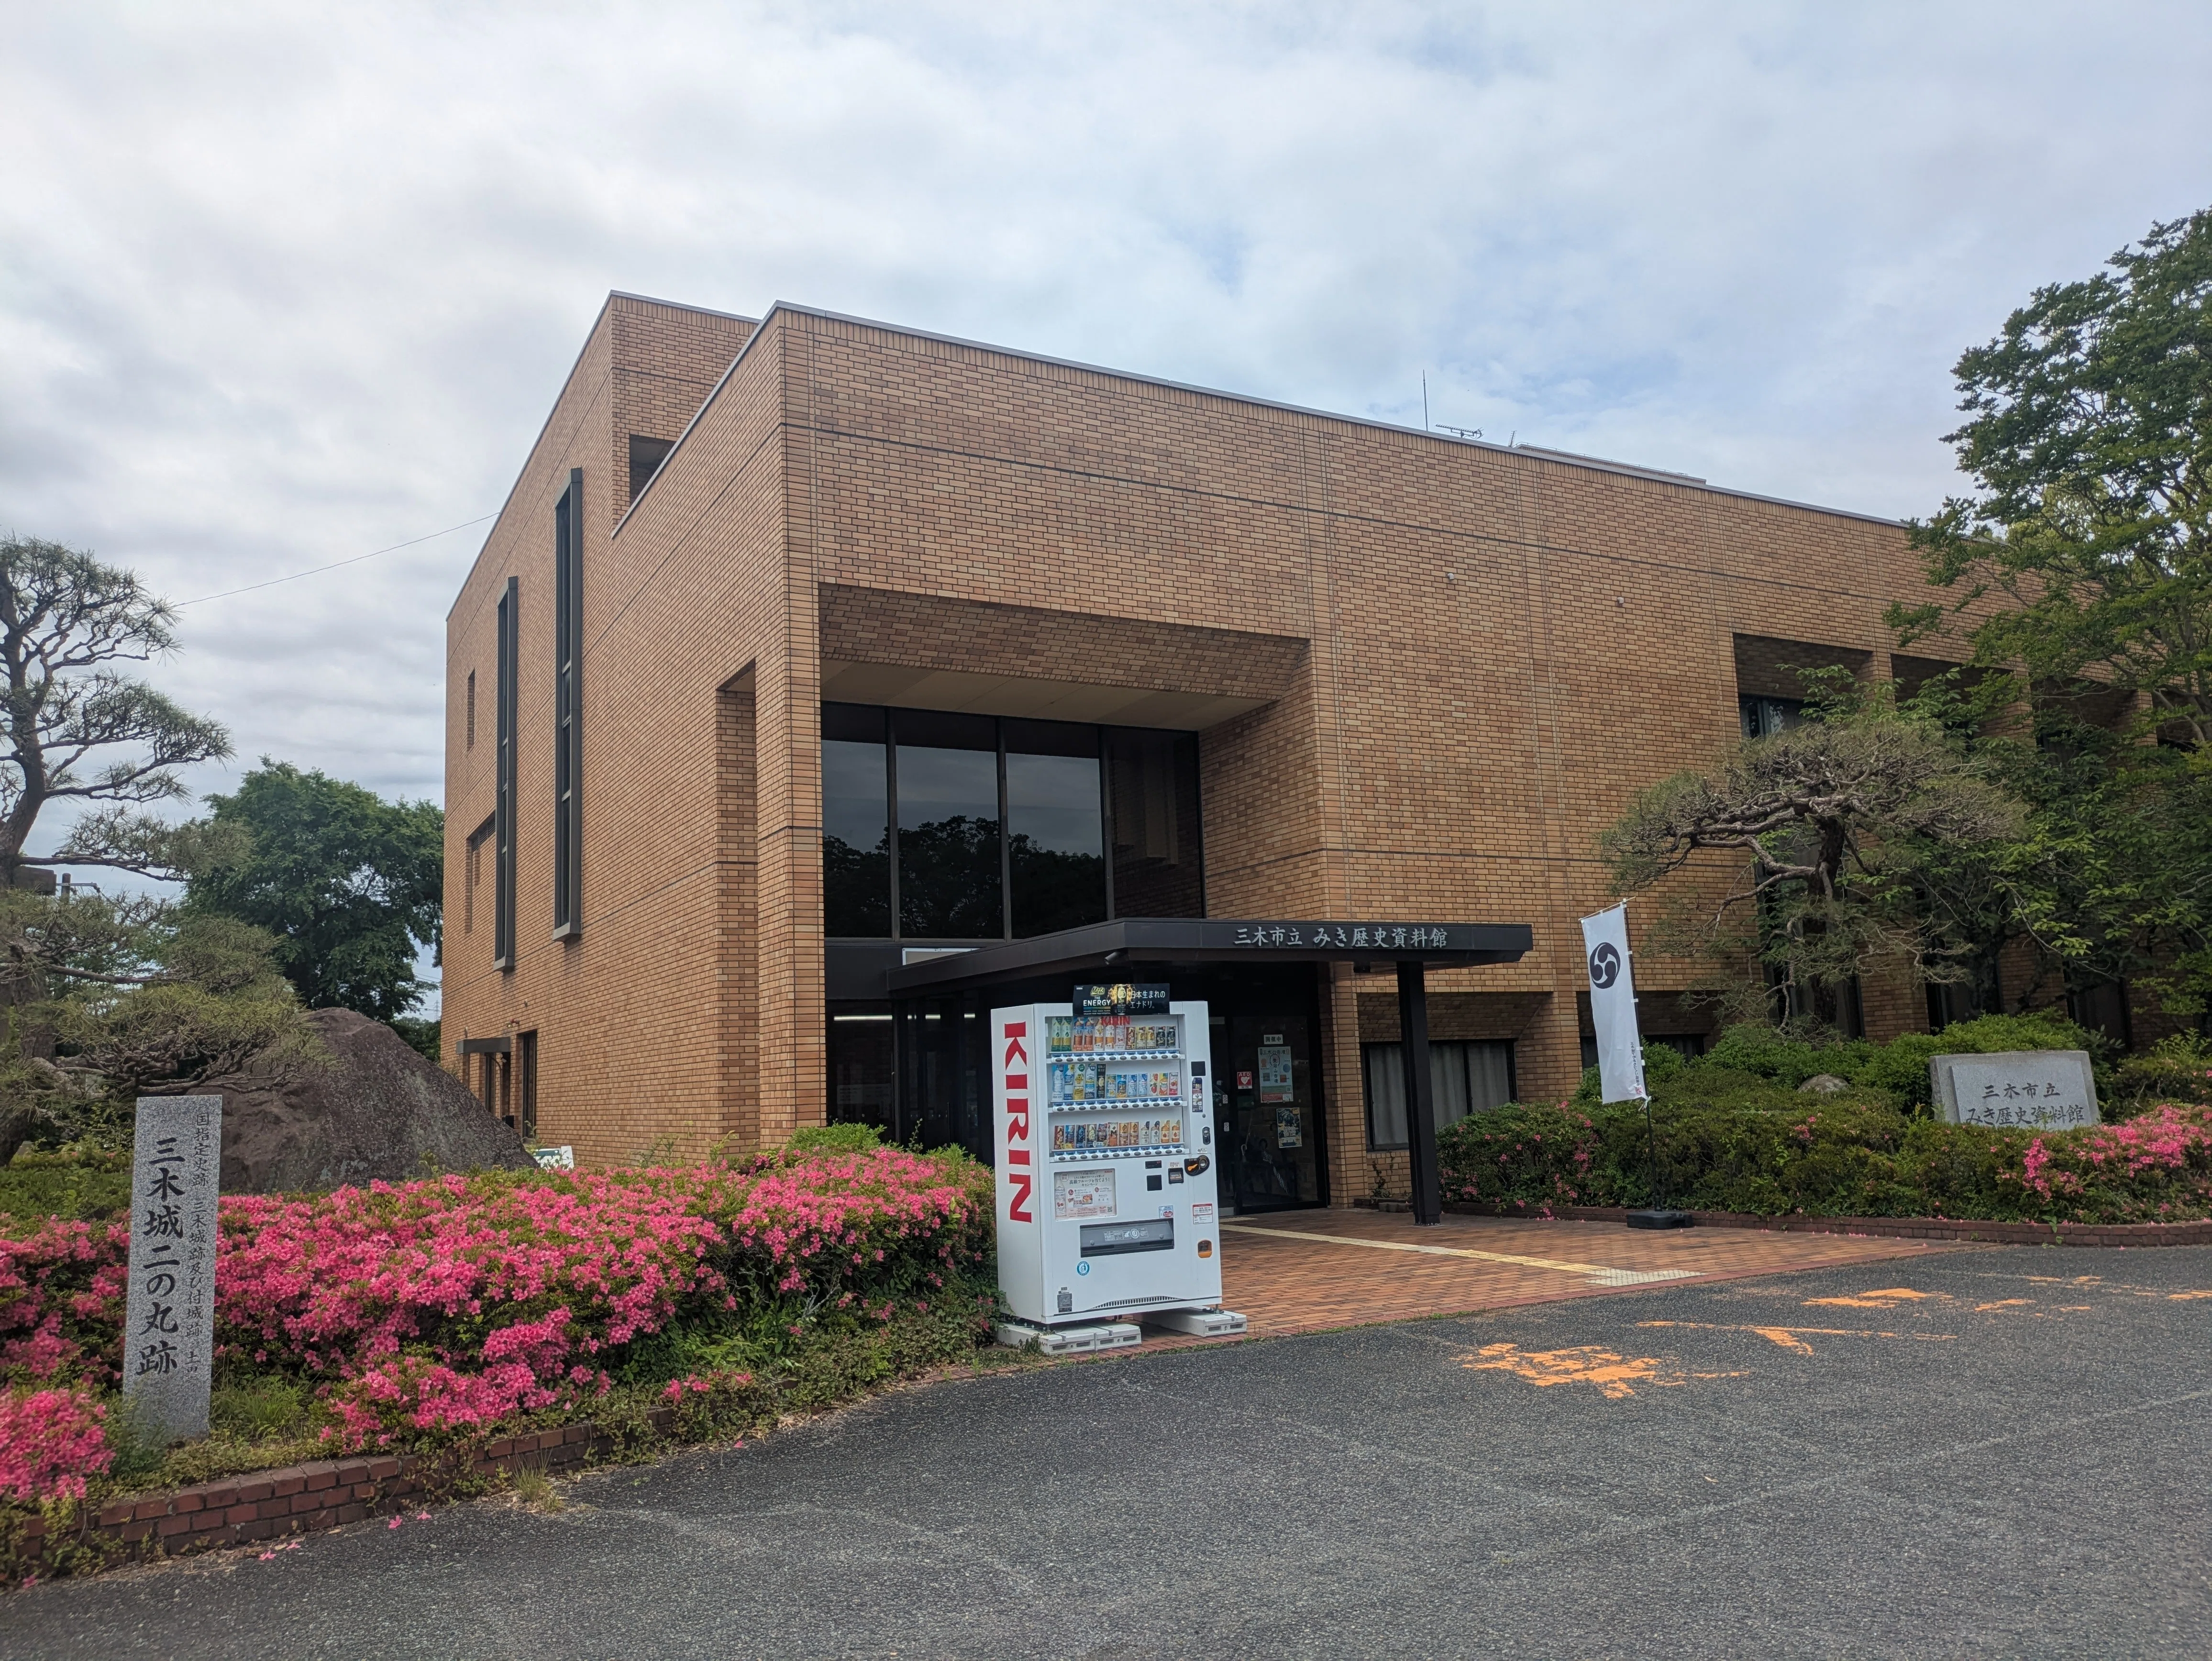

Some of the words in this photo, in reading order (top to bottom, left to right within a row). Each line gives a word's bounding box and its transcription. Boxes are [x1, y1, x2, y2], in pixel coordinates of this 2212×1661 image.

[1233, 926, 1303, 947] 三木市立
[1313, 927, 1448, 949] みき歴史資料館
[1091, 986, 1105, 996] Mets
[1130, 991, 1165, 999] 日本生まれの
[1130, 1001, 1155, 1009] エナドリ。
[1101, 1016, 1130, 1025] KIRIN
[1981, 1082, 2061, 1099] 三木市立
[1004, 1020, 1032, 1224] KIRIN
[1966, 1104, 2084, 1125] みき歴史資料館
[191, 1113, 210, 1187] 国指定史跡
[136, 1137, 186, 1376] 三木城二の丸跡
